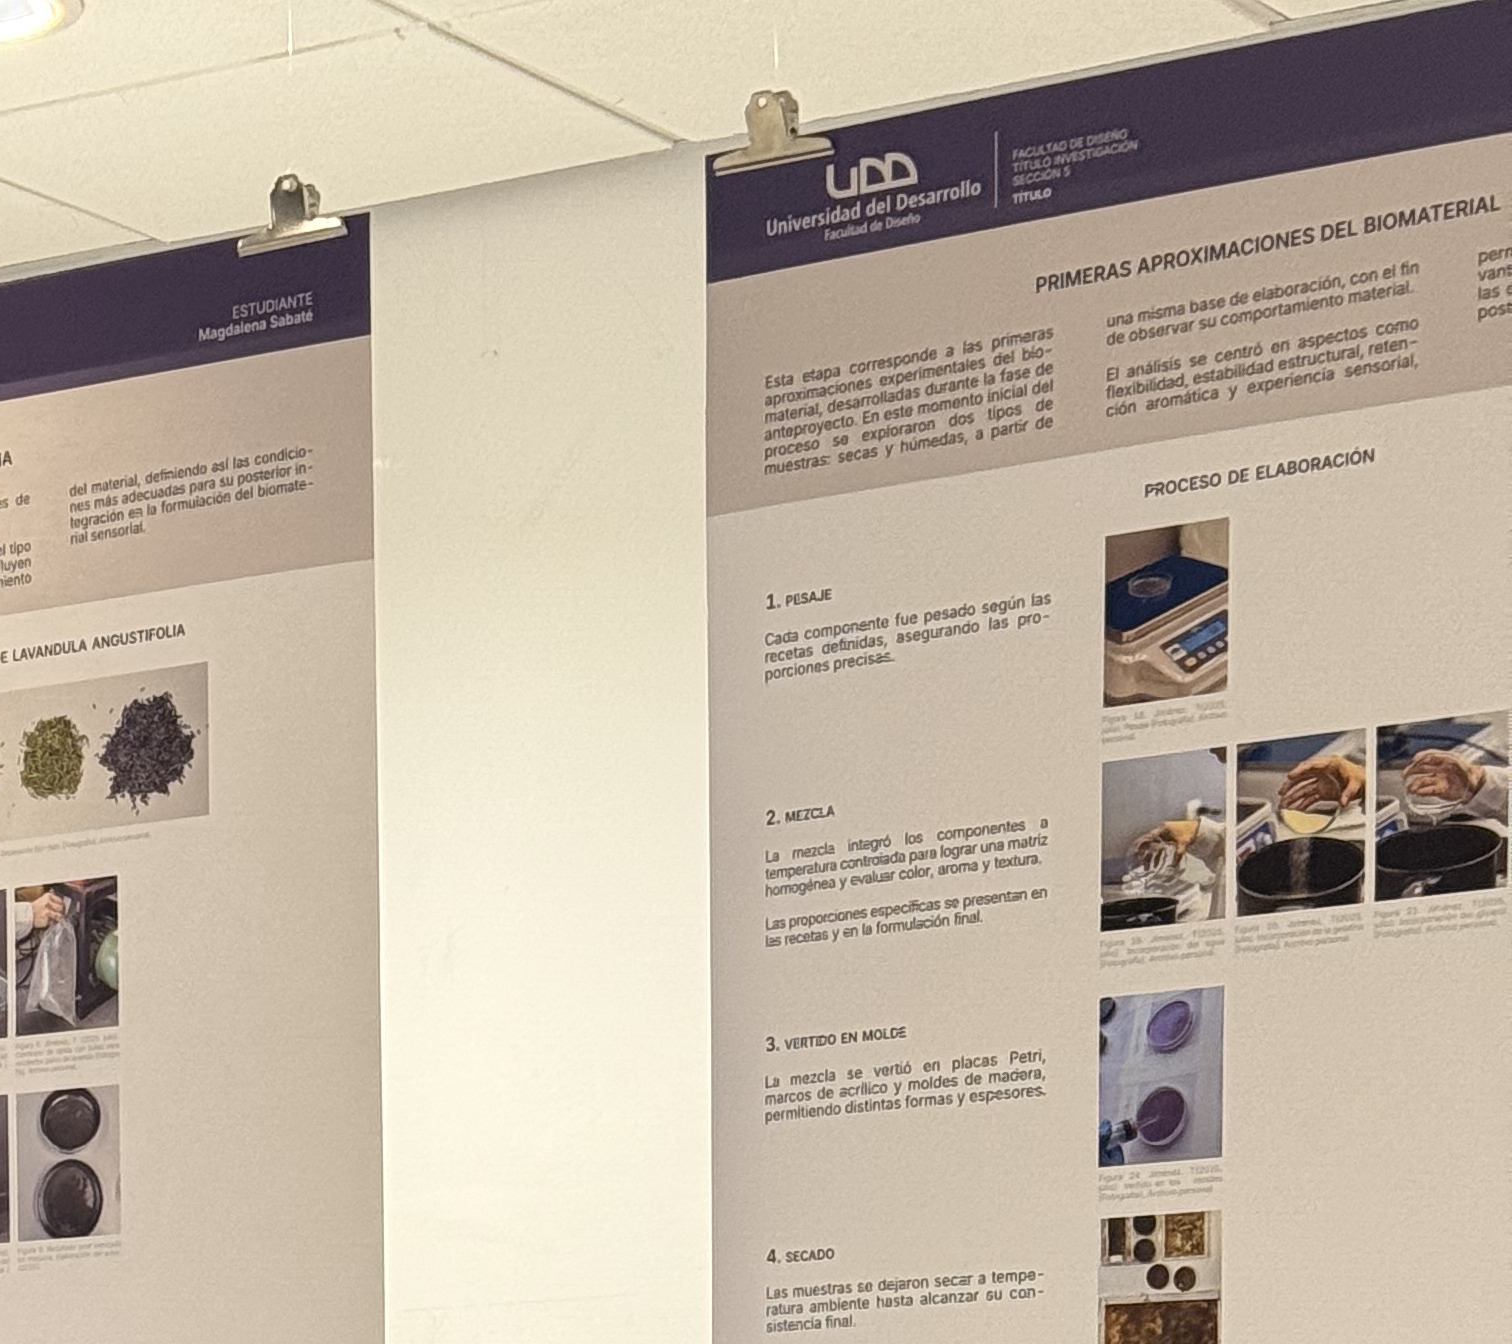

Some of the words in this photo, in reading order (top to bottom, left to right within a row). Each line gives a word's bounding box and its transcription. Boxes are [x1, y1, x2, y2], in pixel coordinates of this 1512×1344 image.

[1012, 140, 1067, 160] FACULTAD
[1069, 136, 1083, 149] DE
[1086, 128, 1127, 146] DISEÑO
[1012, 156, 1051, 172] TÍTULO
[1054, 139, 1138, 164] INVESTIGACIÓN
[766, 201, 860, 236] Universidad
[866, 195, 890, 216] del
[896, 180, 981, 210] Desarrollo
[1036, 260, 1131, 293] PRIMERAS
[1137, 226, 1314, 274] APROXIMACIONES
[1320, 220, 1358, 242] DEL
[1364, 194, 1500, 234] BIOMATERIAL
[232, 291, 313, 319] ESTUDIANTE
[1106, 313, 1133, 328] una
[1138, 303, 1185, 322] misma
[1190, 296, 1225, 313] base
[1229, 291, 1248, 306] de
[1252, 275, 1345, 302] elaboración,
[1350, 270, 1378, 286] con
[1382, 264, 1396, 279] el
[1400, 262, 1419, 275] fin
[1106, 331, 1124, 346] de
[1128, 320, 1194, 342] observar
[1198, 316, 1216, 330] su
[1220, 294, 1343, 326] comportamiento
[1348, 280, 1413, 304] material.
[198, 320, 267, 341] Magdalena
[269, 309, 314, 328] Sabaté
[1106, 366, 1119, 382] El
[1126, 356, 1181, 378] análisis
[1189, 354, 1207, 367] se
[1214, 342, 1263, 363] centró
[1270, 340, 1290, 353] en
[1298, 326, 1368, 349] aspectos
[1376, 318, 1419, 336] como
[1106, 372, 1188, 399] flexibilidad,
[1193, 358, 1274, 384] estabilidad
[1278, 343, 1363, 370] estructural,
[1368, 338, 1417, 355] reten-
[1106, 401, 1136, 417] ción
[1146, 388, 1219, 411] aromática
[1228, 385, 1237, 401] y
[1247, 369, 1334, 394] experiencia
[1344, 355, 1418, 378] sensorial,
[69, 482, 87, 497] del
[91, 473, 140, 493] material,
[145, 463, 207, 484] definiendo
[211, 457, 228, 473] así
[233, 456, 249, 469] las
[254, 447, 312, 465] condicio-
[1144, 472, 1221, 498] PROCESO
[1228, 467, 1249, 485] DE
[1256, 446, 1374, 480] ELABORACIÓN
[766, 593, 781, 610] 1.
[786, 588, 832, 607] PESAJE
[12, 639, 87, 661] LAVANDULA
[92, 623, 185, 650] ANGUSTIFOLIA
[766, 809, 780, 826] 2.
[785, 805, 835, 823] MEZCLA
[766, 1036, 779, 1052] 3.
[784, 1033, 836, 1050] VERTIDO
[841, 1031, 857, 1044] EN
[862, 1026, 906, 1041] MOLDE
[766, 1248, 780, 1263] 4.
[786, 1247, 834, 1263] SECADO
